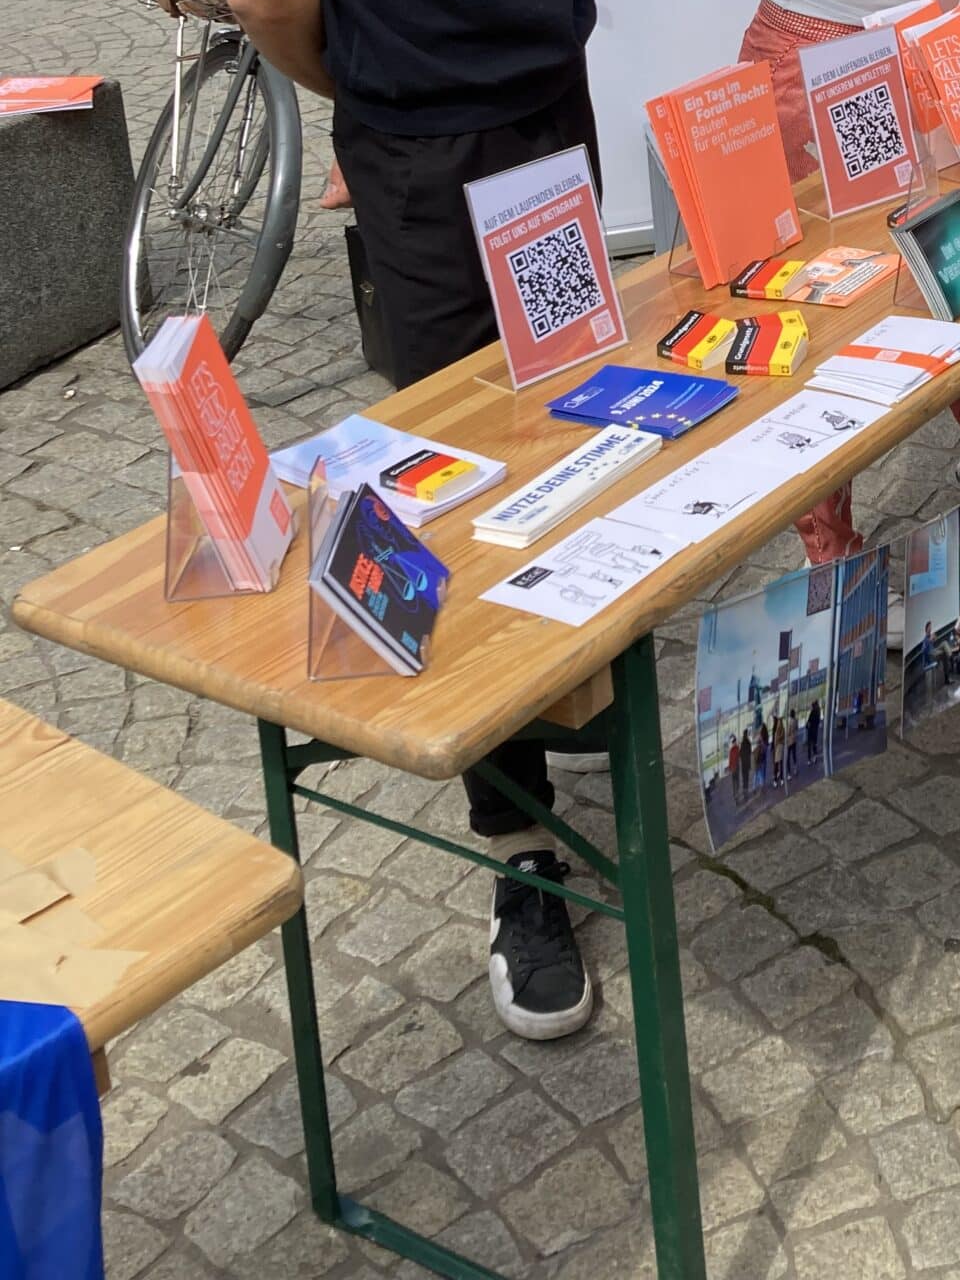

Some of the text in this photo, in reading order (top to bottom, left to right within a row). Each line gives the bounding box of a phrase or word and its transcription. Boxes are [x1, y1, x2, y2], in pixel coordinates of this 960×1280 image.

[684, 81, 741, 112] Ein Tag im
[696, 84, 769, 122] Forum Recht:
[691, 116, 727, 139] Bauten
[712, 132, 727, 145] ein
[729, 119, 756, 136] neues
[721, 123, 776, 156] Miteinander
[484, 216, 499, 231] AUF
[498, 208, 516, 223] DEM
[516, 188, 555, 215] LAUFENDEN
[489, 193, 583, 251] FOLGT UNS AUF INSTAGRAM!
[665, 313, 699, 346] Grundgesetz
[734, 327, 754, 360] Grundgesetz
[492, 491, 545, 522] NUTZE
[540, 466, 582, 494] DEINE
[575, 434, 630, 468] STIMME.
